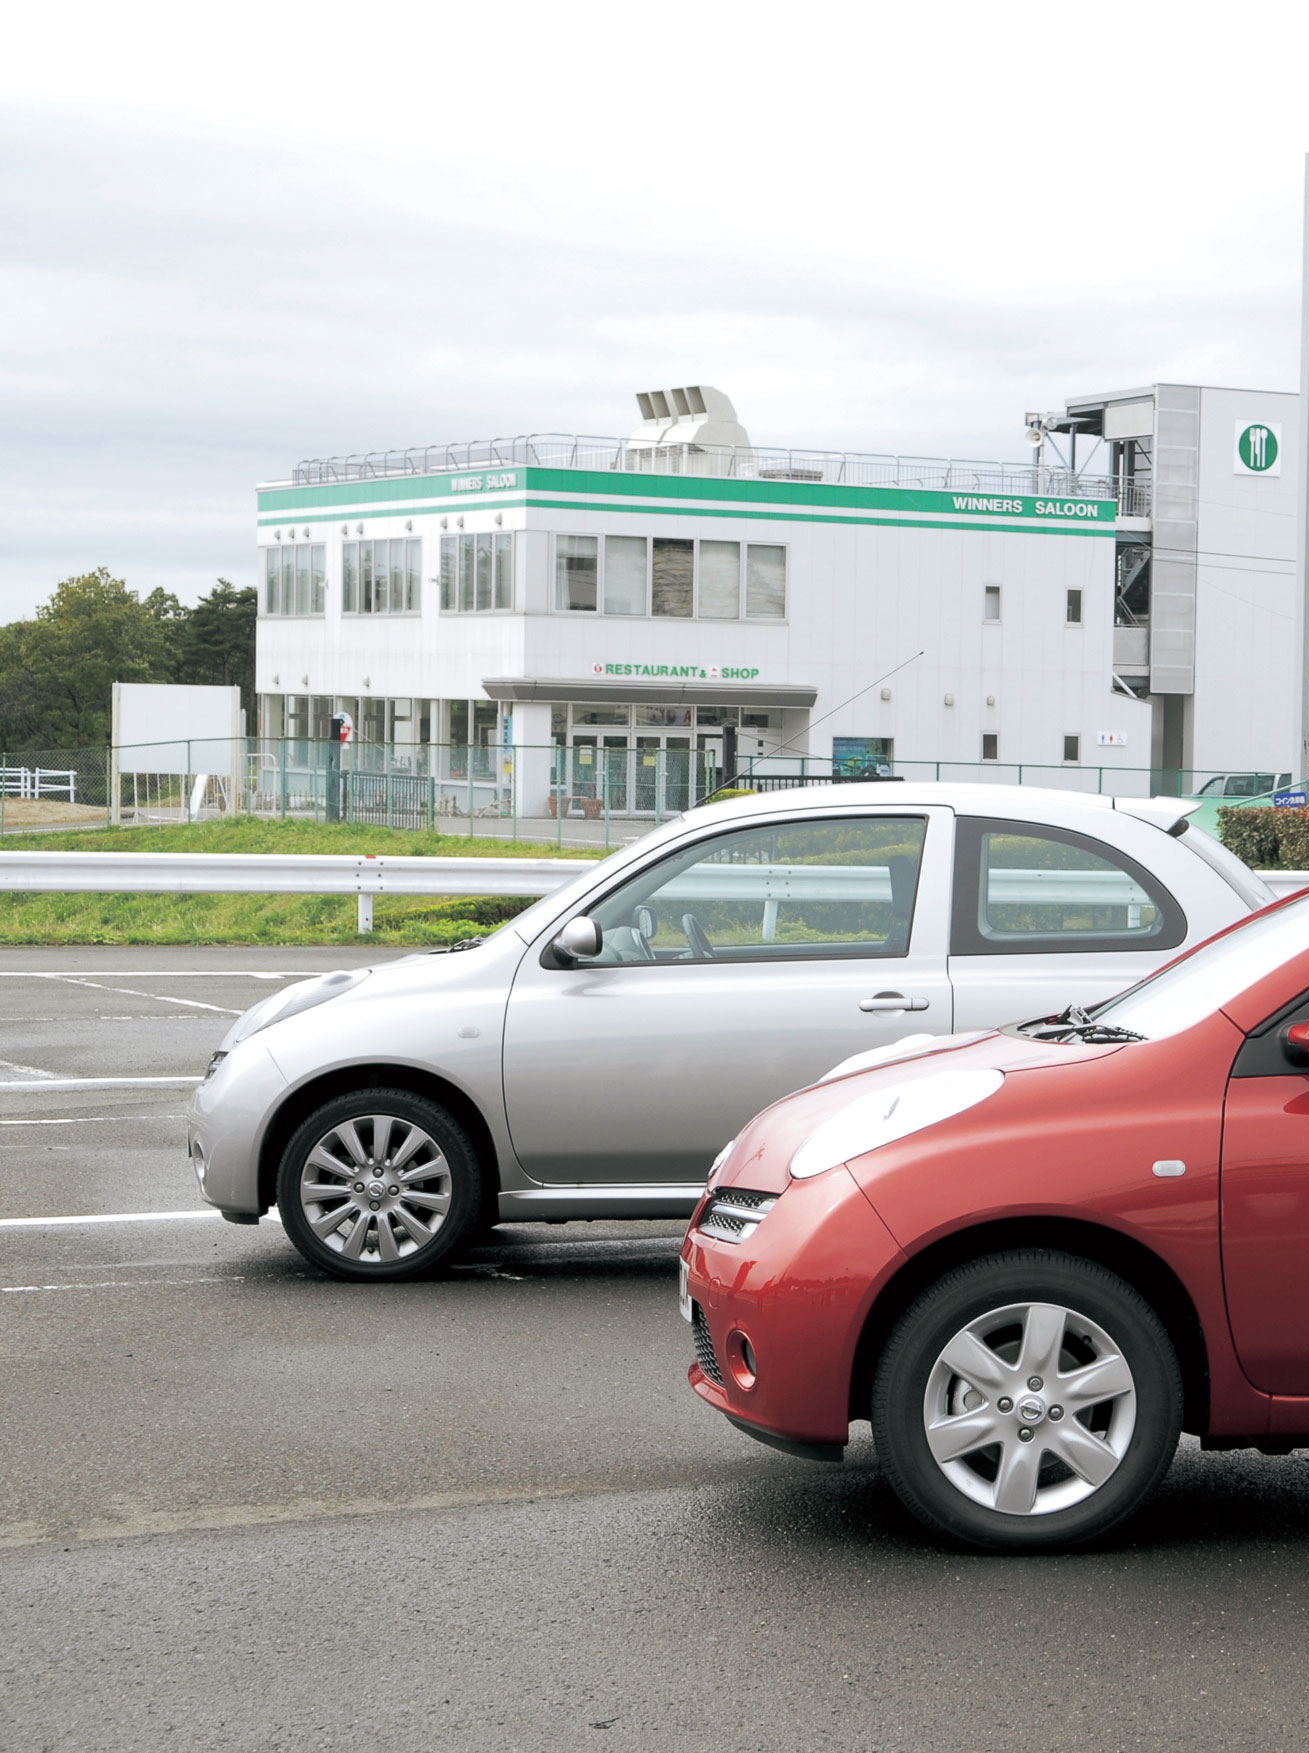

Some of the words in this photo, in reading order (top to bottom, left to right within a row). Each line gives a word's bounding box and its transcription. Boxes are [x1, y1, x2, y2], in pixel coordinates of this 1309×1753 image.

[486, 473, 518, 489] SALOON
[952, 496, 1023, 513] WINNERS
[1035, 501, 1098, 517] SALOON
[605, 663, 698, 677] RESTAURANT
[721, 667, 759, 679] SHOP
